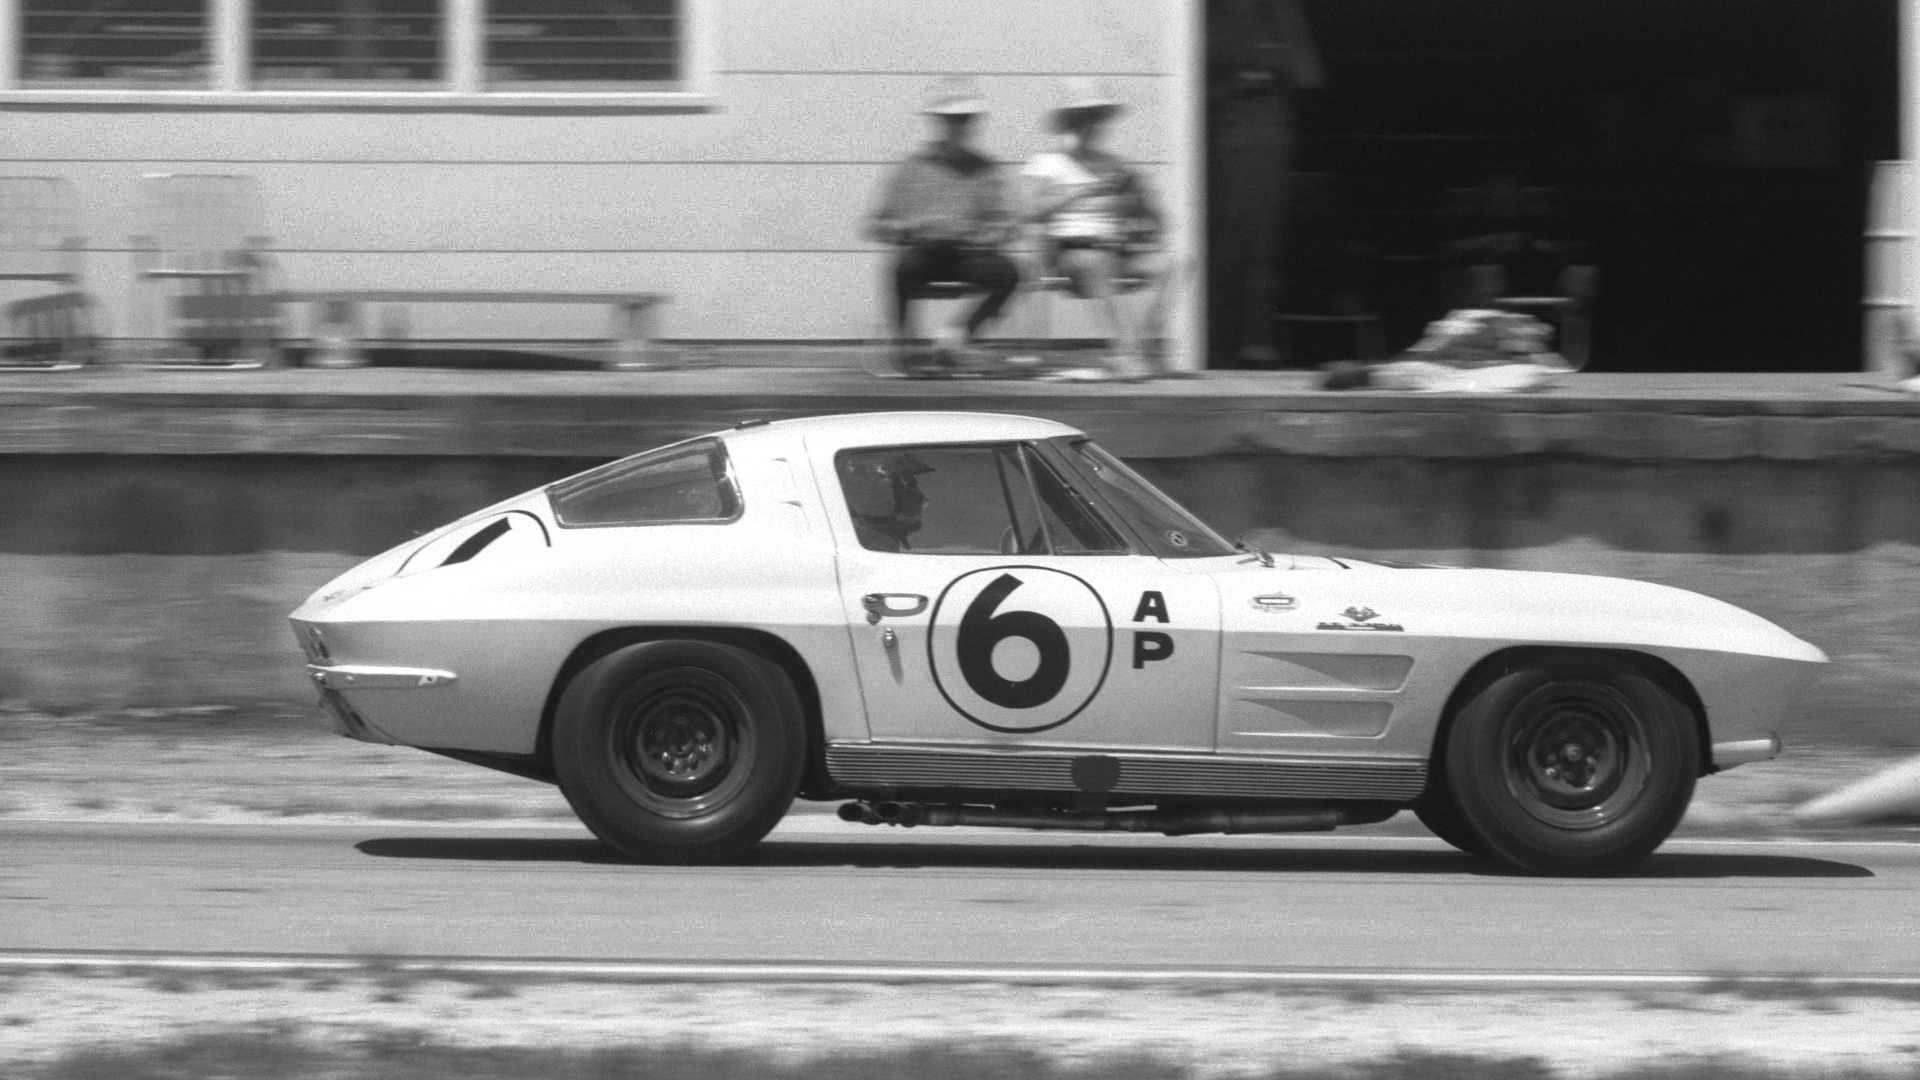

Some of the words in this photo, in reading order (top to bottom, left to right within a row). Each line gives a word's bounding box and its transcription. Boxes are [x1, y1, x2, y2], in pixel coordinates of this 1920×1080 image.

[1132, 591, 1170, 623] A
[956, 573, 1071, 710] 6
[1132, 631, 1175, 670] P
